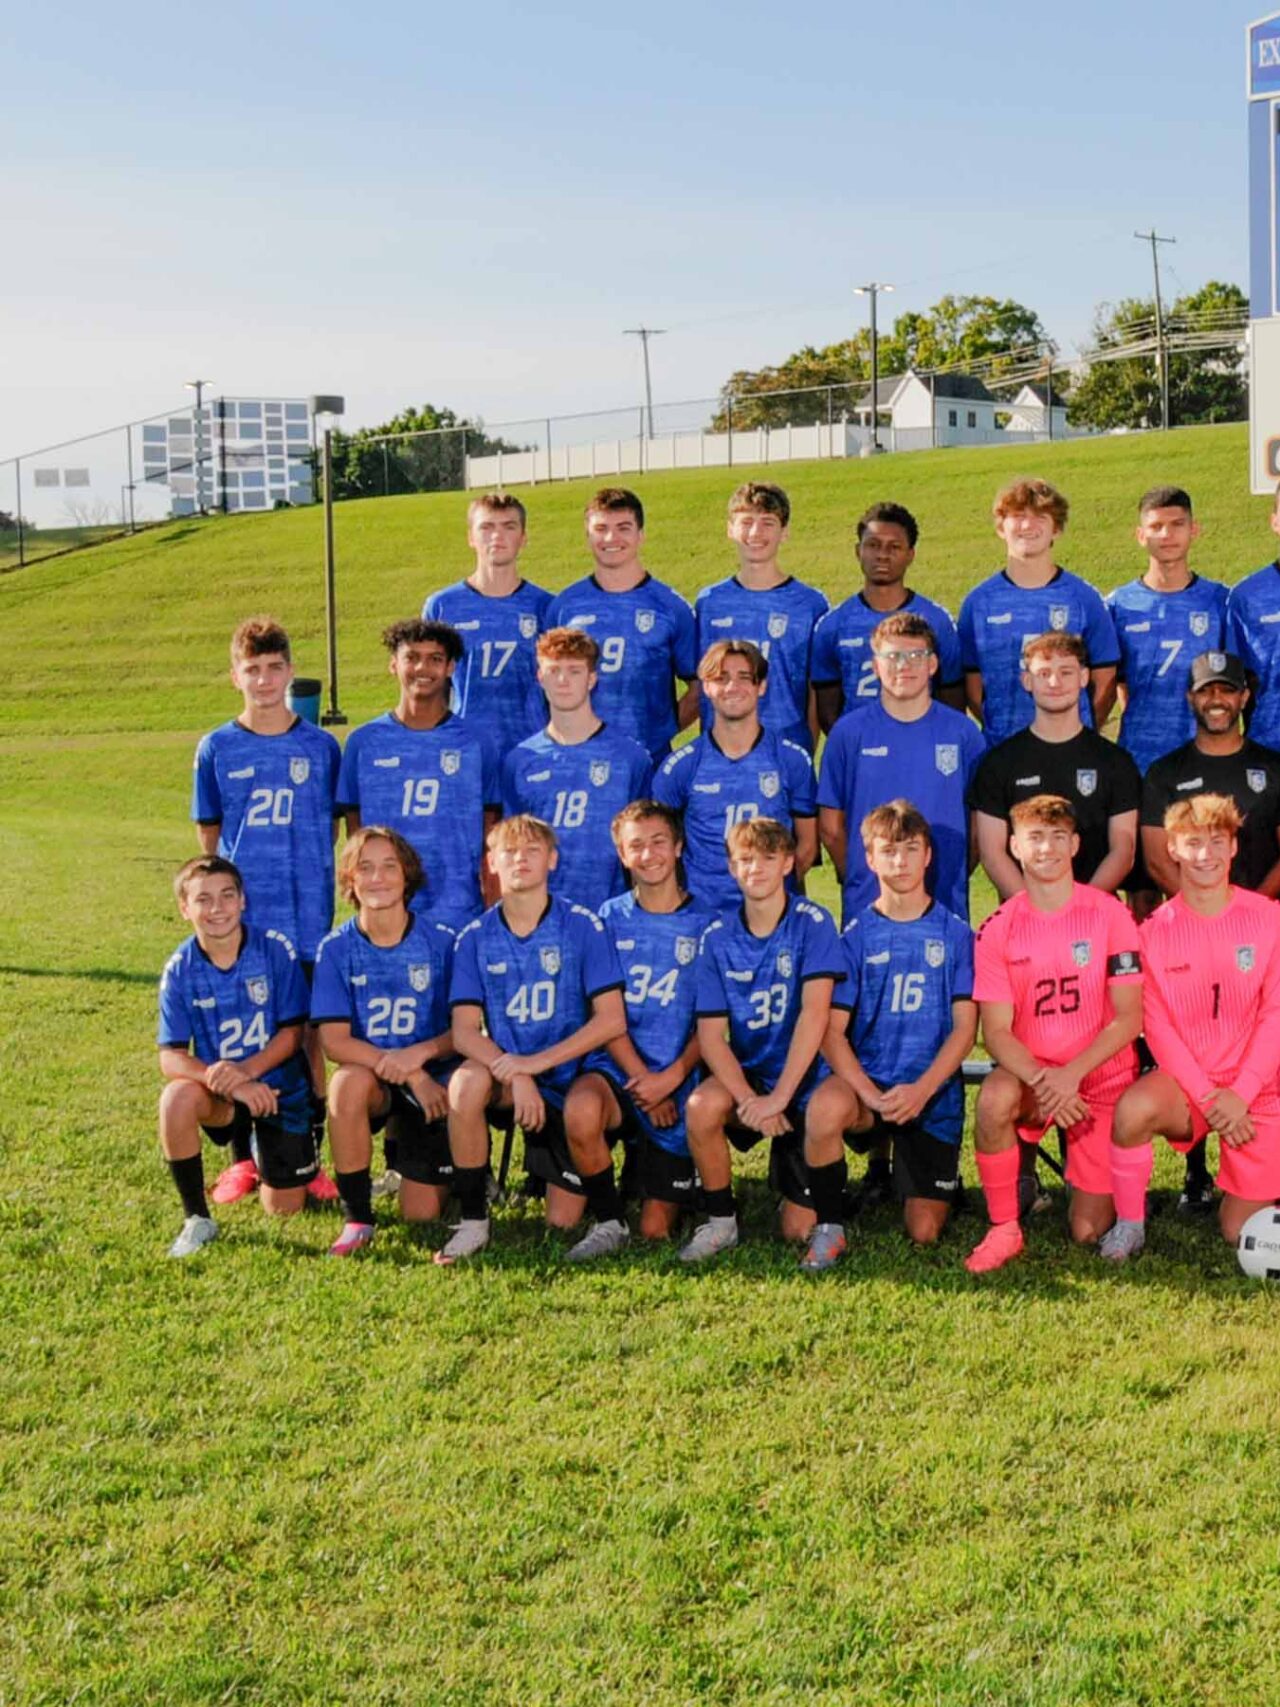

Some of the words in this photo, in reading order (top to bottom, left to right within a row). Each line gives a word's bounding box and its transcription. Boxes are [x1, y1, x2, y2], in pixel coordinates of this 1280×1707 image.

[481, 641, 517, 678] 17
[601, 637, 625, 672] 9
[1157, 639, 1183, 676] 7
[247, 789, 293, 825] 20
[402, 779, 440, 816] 19
[553, 790, 587, 827] 18
[506, 981, 556, 1023] 40
[625, 965, 679, 1006] 34
[891, 974, 925, 1012] 16
[1034, 975, 1080, 1017] 25
[1211, 983, 1221, 1019] 1
[367, 997, 417, 1037] 26
[748, 984, 788, 1029] 33
[219, 1011, 270, 1058] 24
